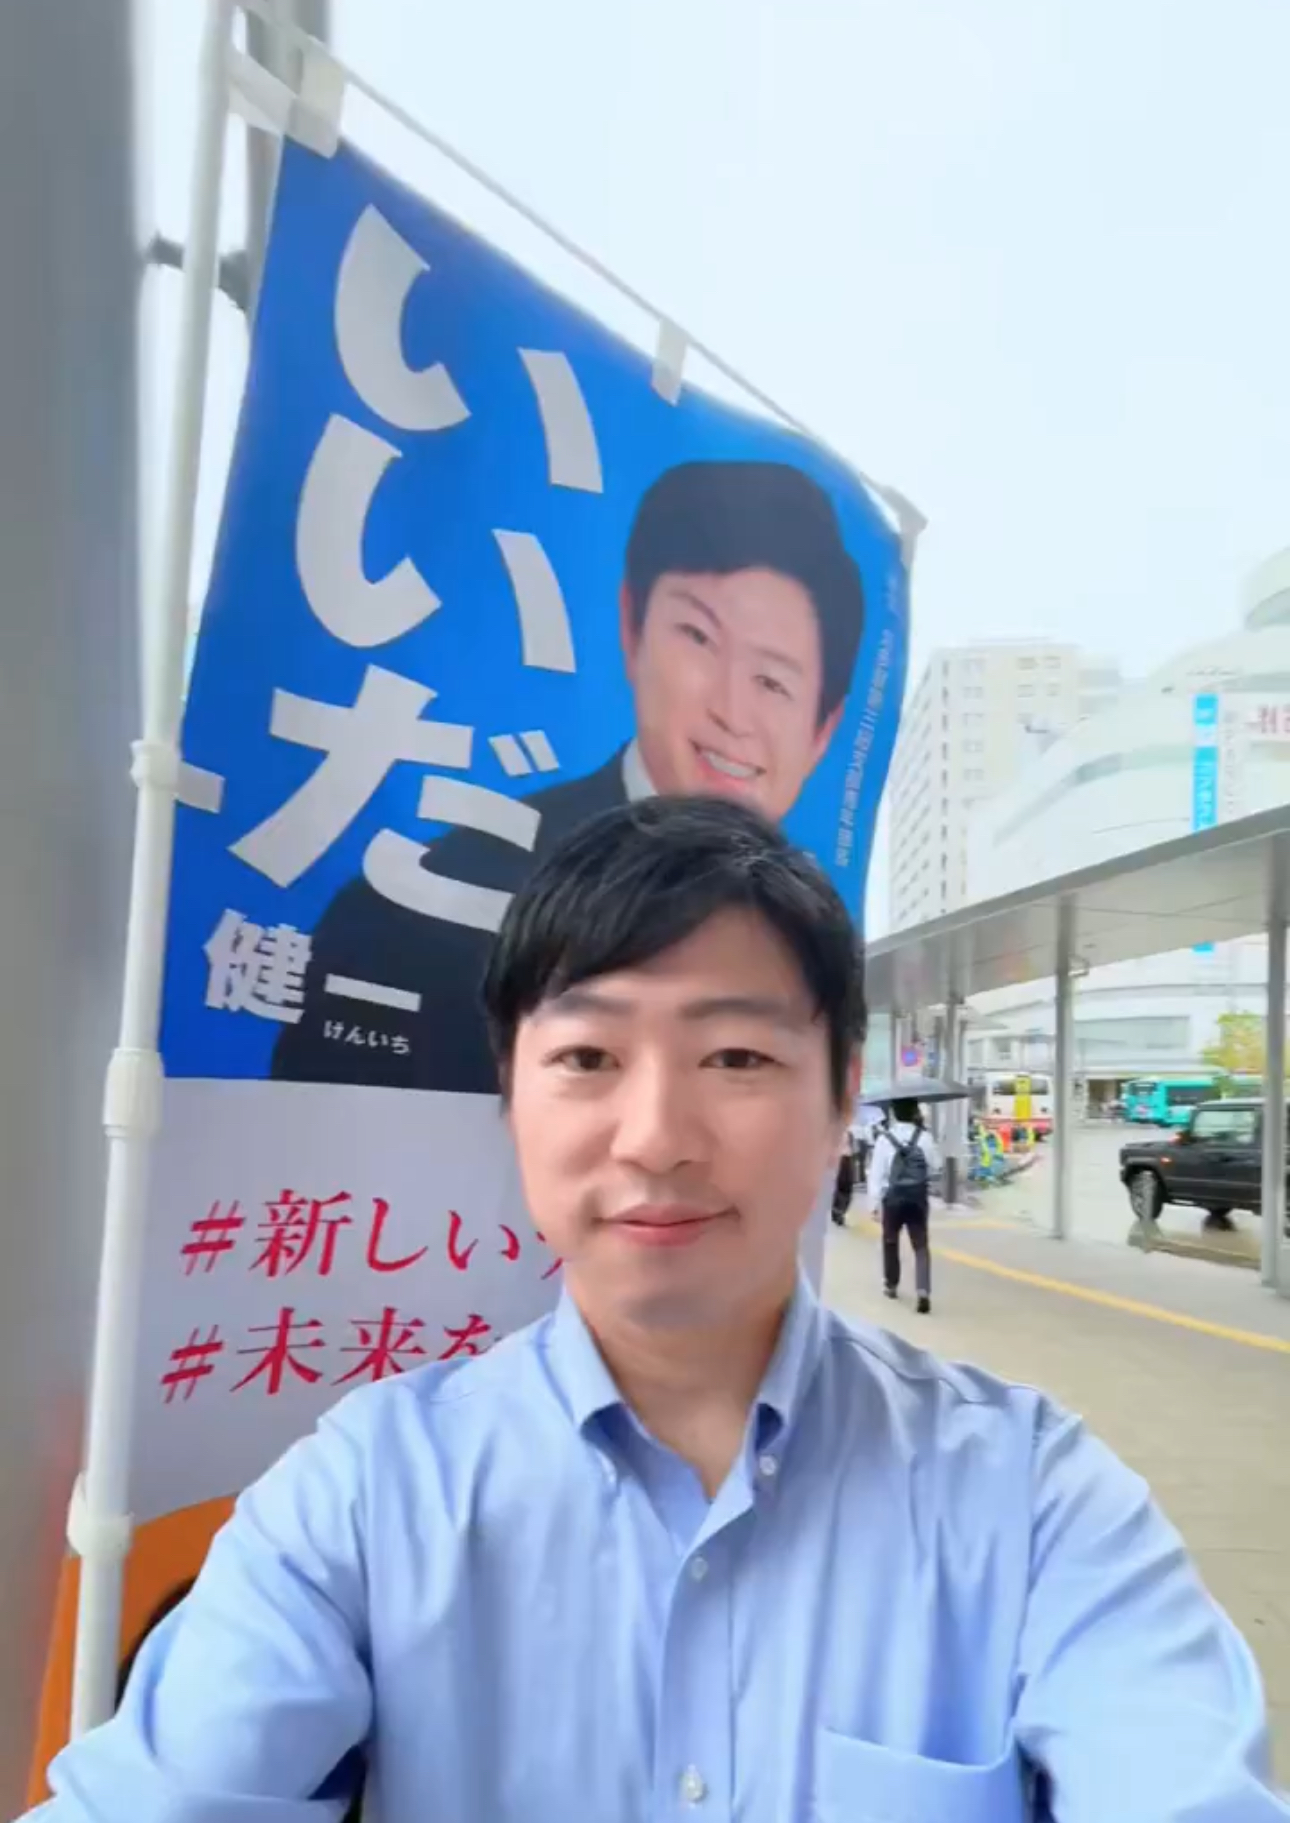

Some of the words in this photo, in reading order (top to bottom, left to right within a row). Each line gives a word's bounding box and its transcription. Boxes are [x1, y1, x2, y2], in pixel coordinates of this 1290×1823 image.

[227, 203, 605, 933] いいだ
[203, 908, 422, 1025] 健一
[322, 1020, 411, 1055] けんいち
[180, 1188, 564, 1281] #新しい
